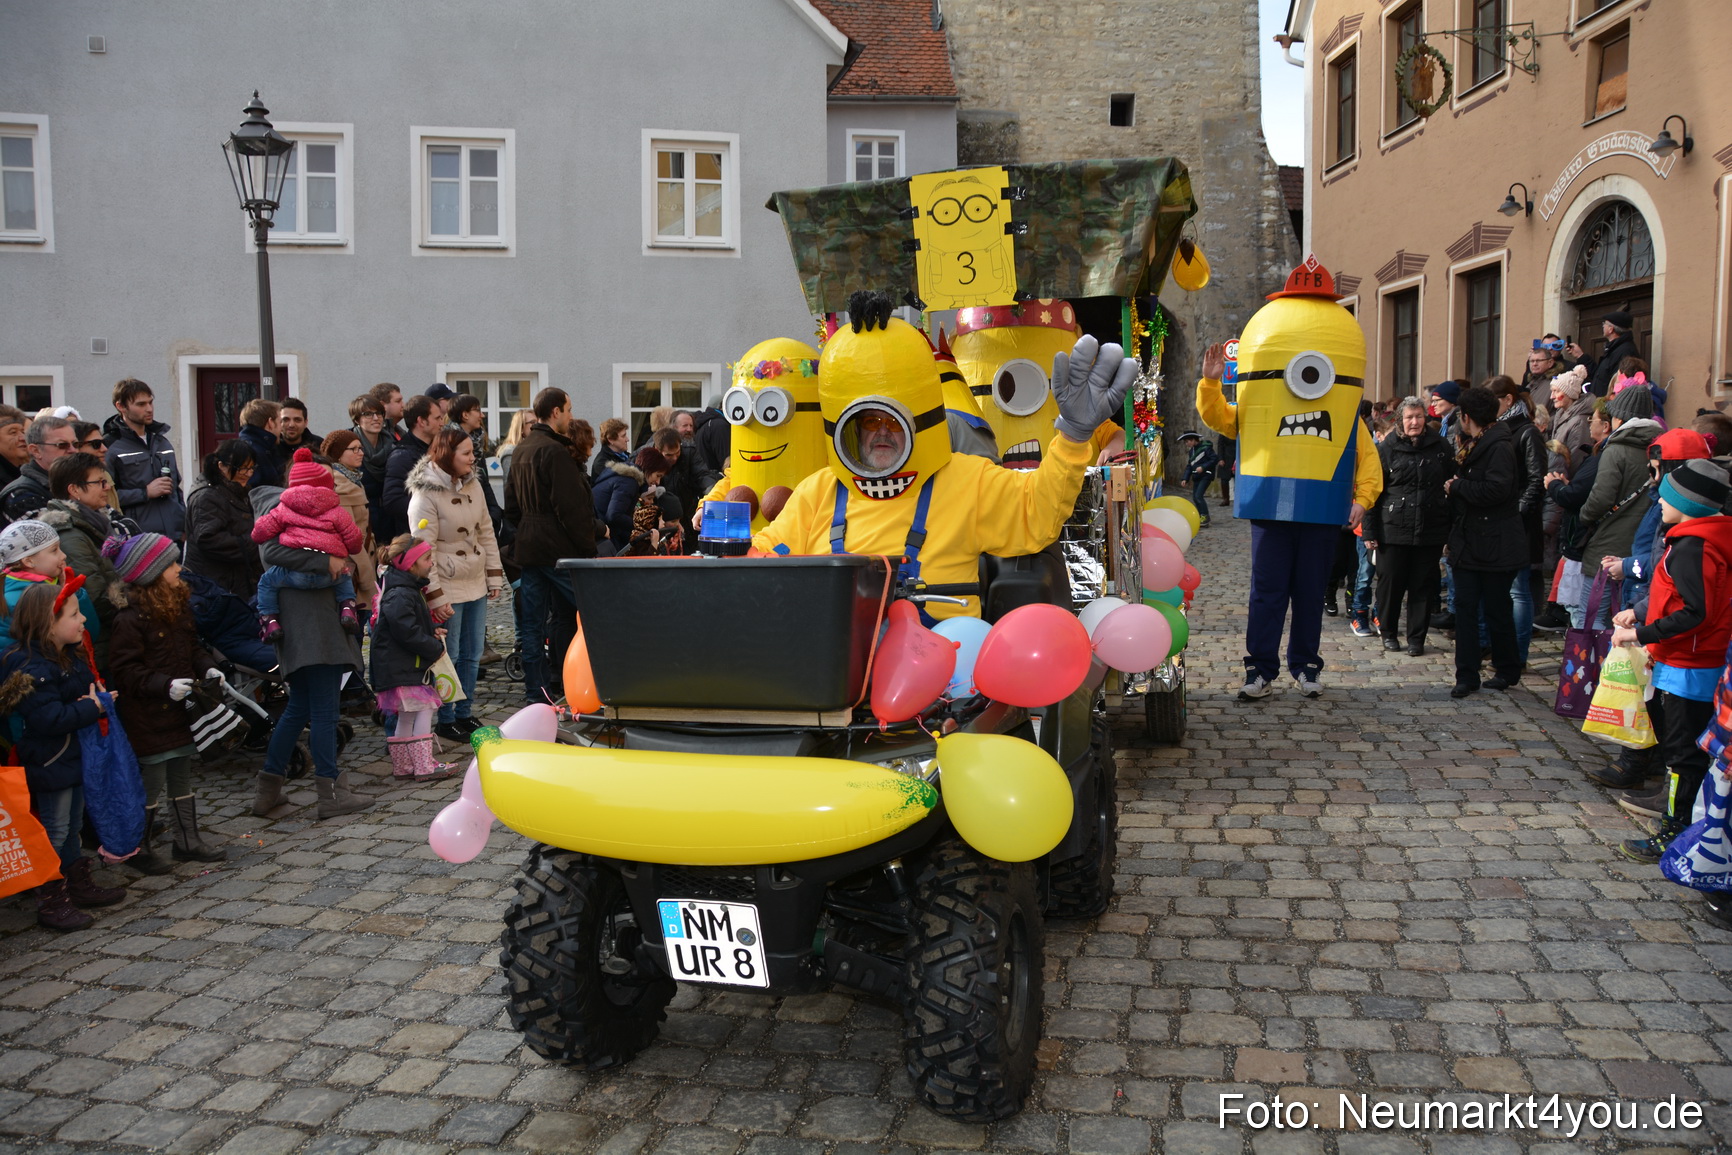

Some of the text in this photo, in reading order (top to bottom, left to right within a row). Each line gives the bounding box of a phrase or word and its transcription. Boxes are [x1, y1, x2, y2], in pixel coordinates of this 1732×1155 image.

[957, 251, 976, 285] 3
[1308, 256, 1315, 268] 3
[1294, 273, 1322, 287] FFB
[668, 924, 679, 934] D
[682, 907, 734, 942] NM
[674, 944, 755, 979] UR 8
